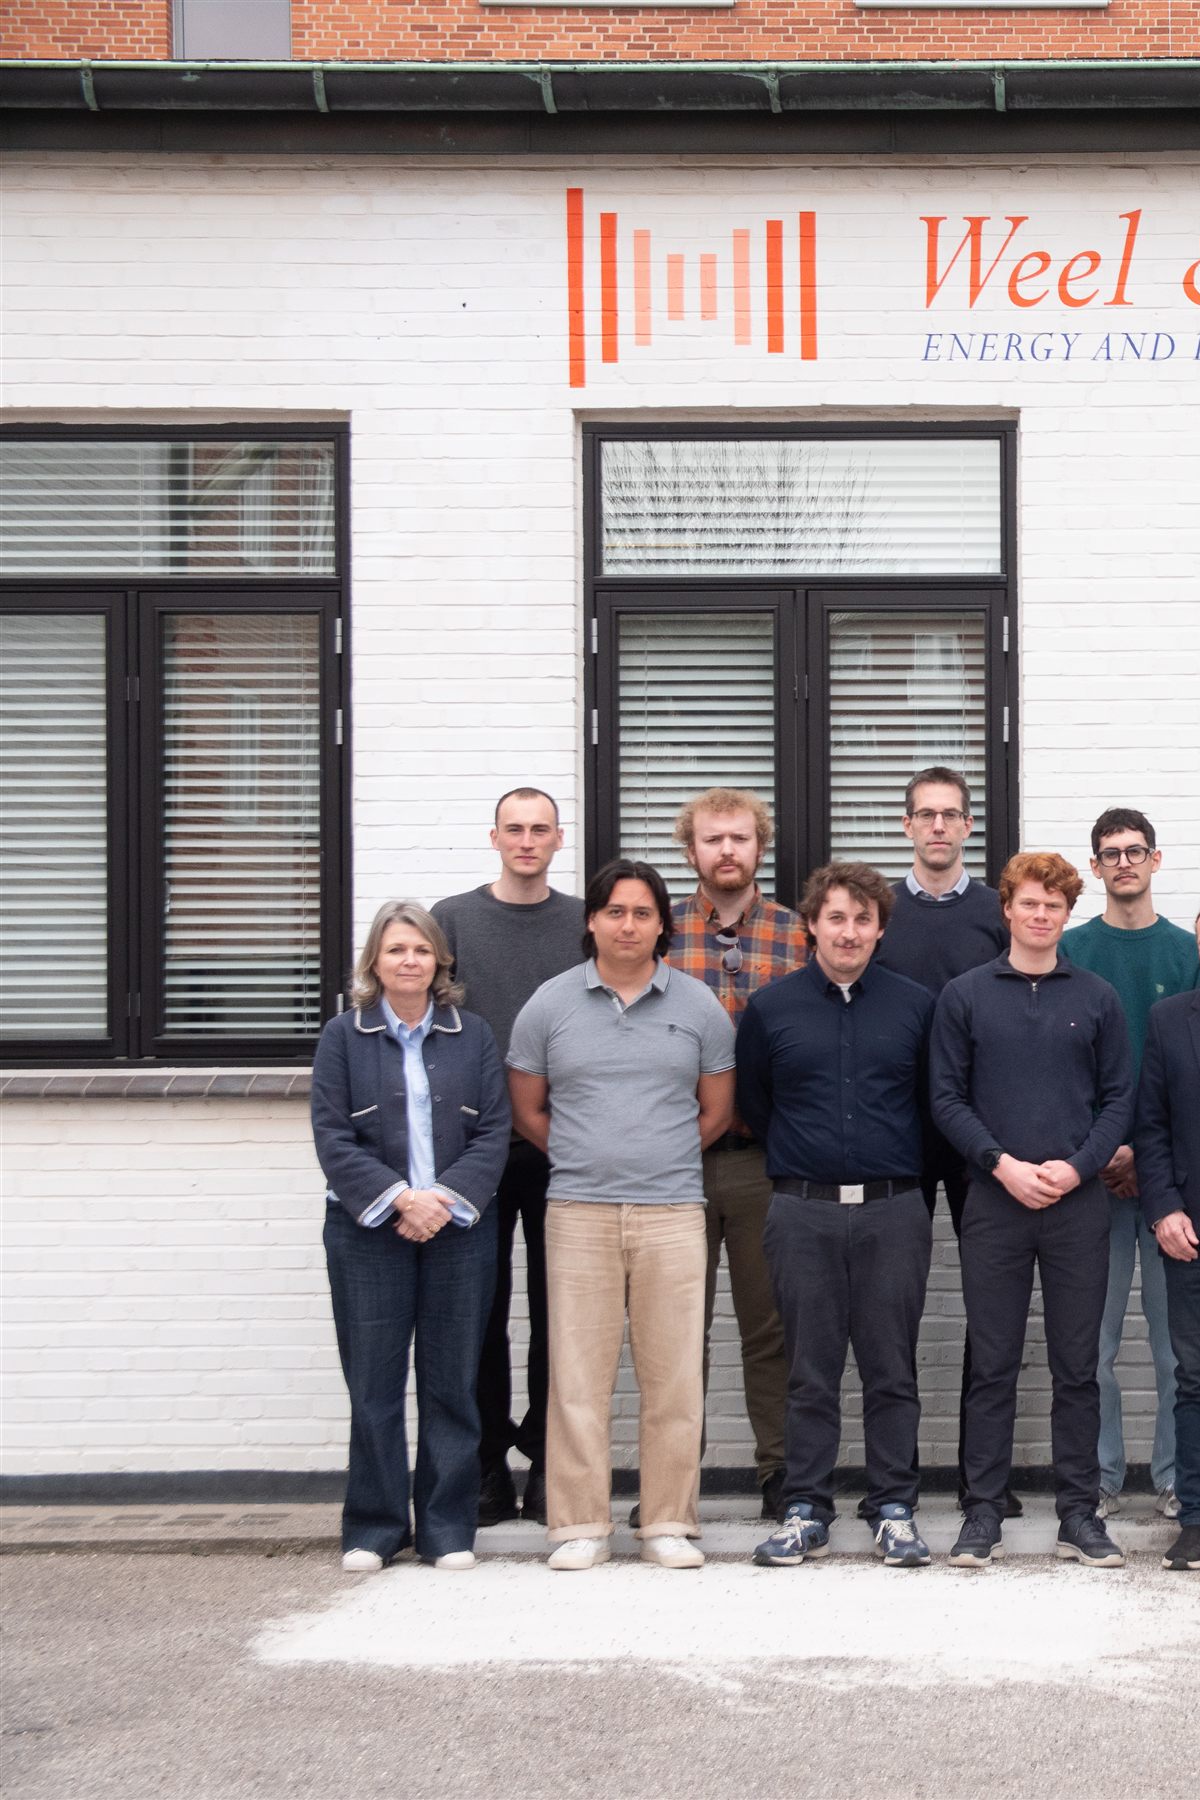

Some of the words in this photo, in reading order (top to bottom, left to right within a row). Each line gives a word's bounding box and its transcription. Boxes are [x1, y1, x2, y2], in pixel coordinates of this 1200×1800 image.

[919, 208, 1143, 308] Weel
[923, 331, 1081, 362] ENERGY
[1092, 330, 1177, 362] AND
